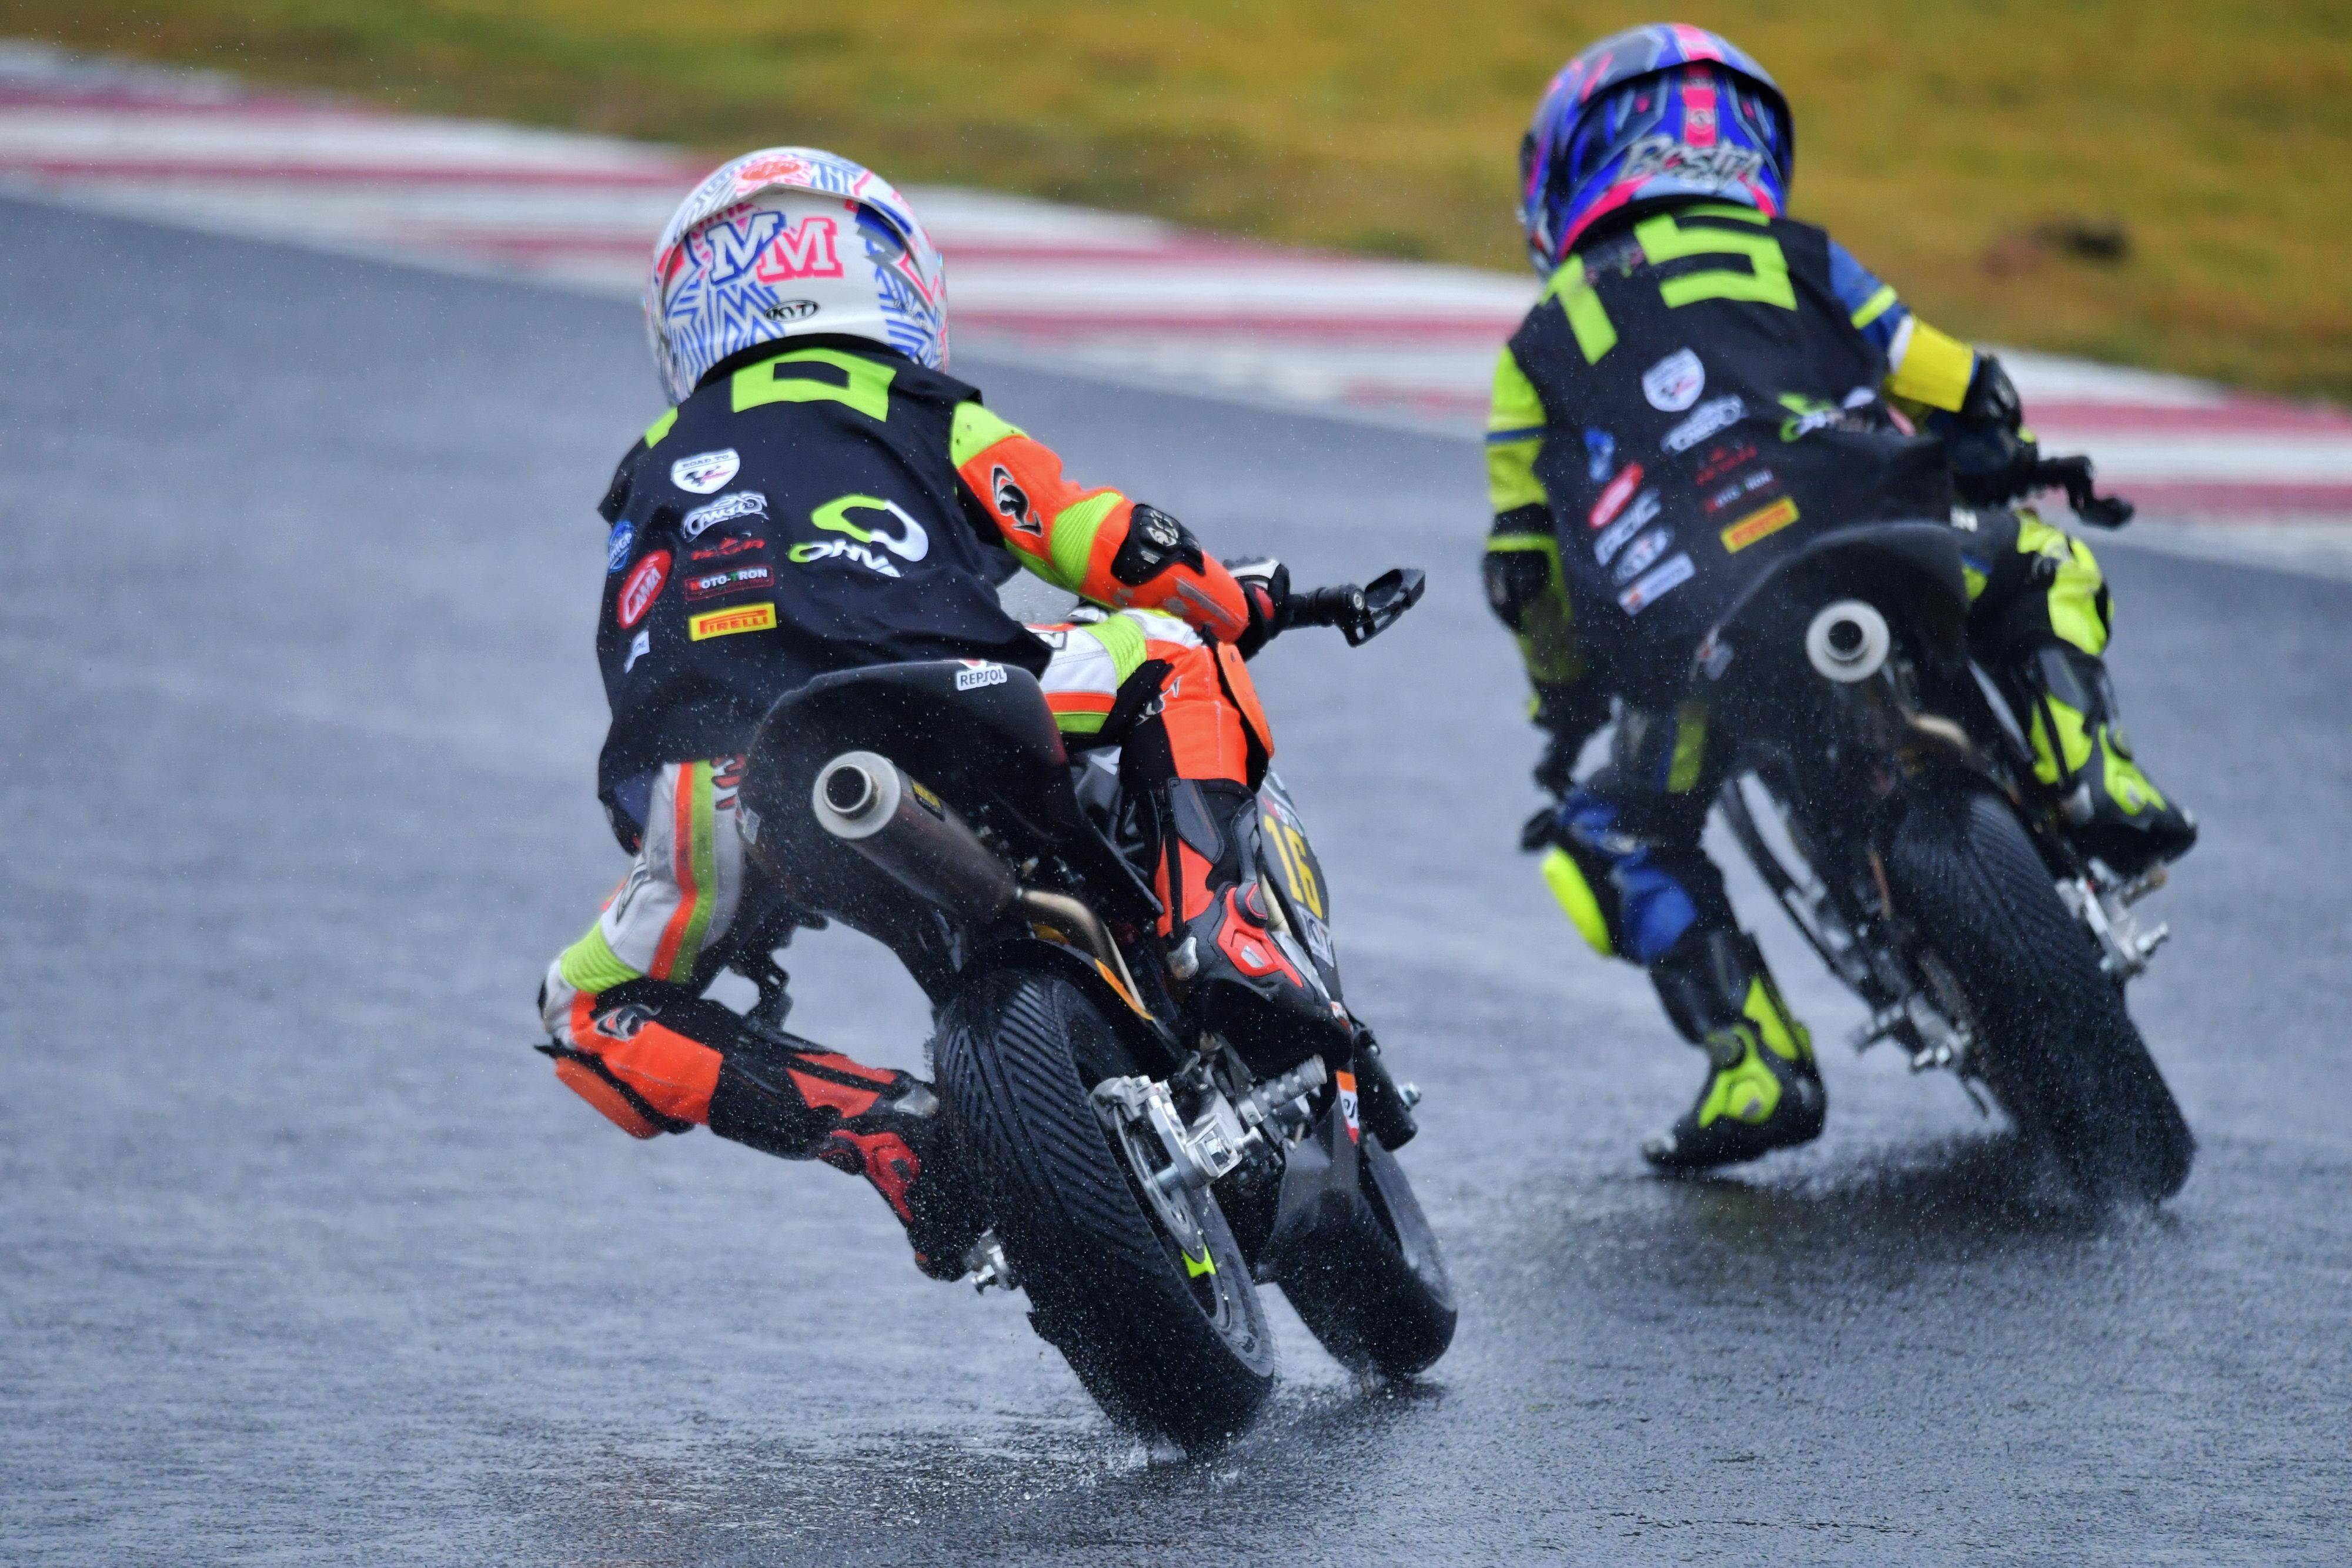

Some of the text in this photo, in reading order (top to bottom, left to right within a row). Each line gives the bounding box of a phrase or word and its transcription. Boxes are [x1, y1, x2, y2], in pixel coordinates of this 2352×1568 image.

[772, 303, 813, 320] KYT
[681, 458, 711, 469] ROAD
[700, 609, 768, 636] PIRELLI
[960, 669, 1004, 687] REPSOL
[1264, 815, 1323, 920] 16
